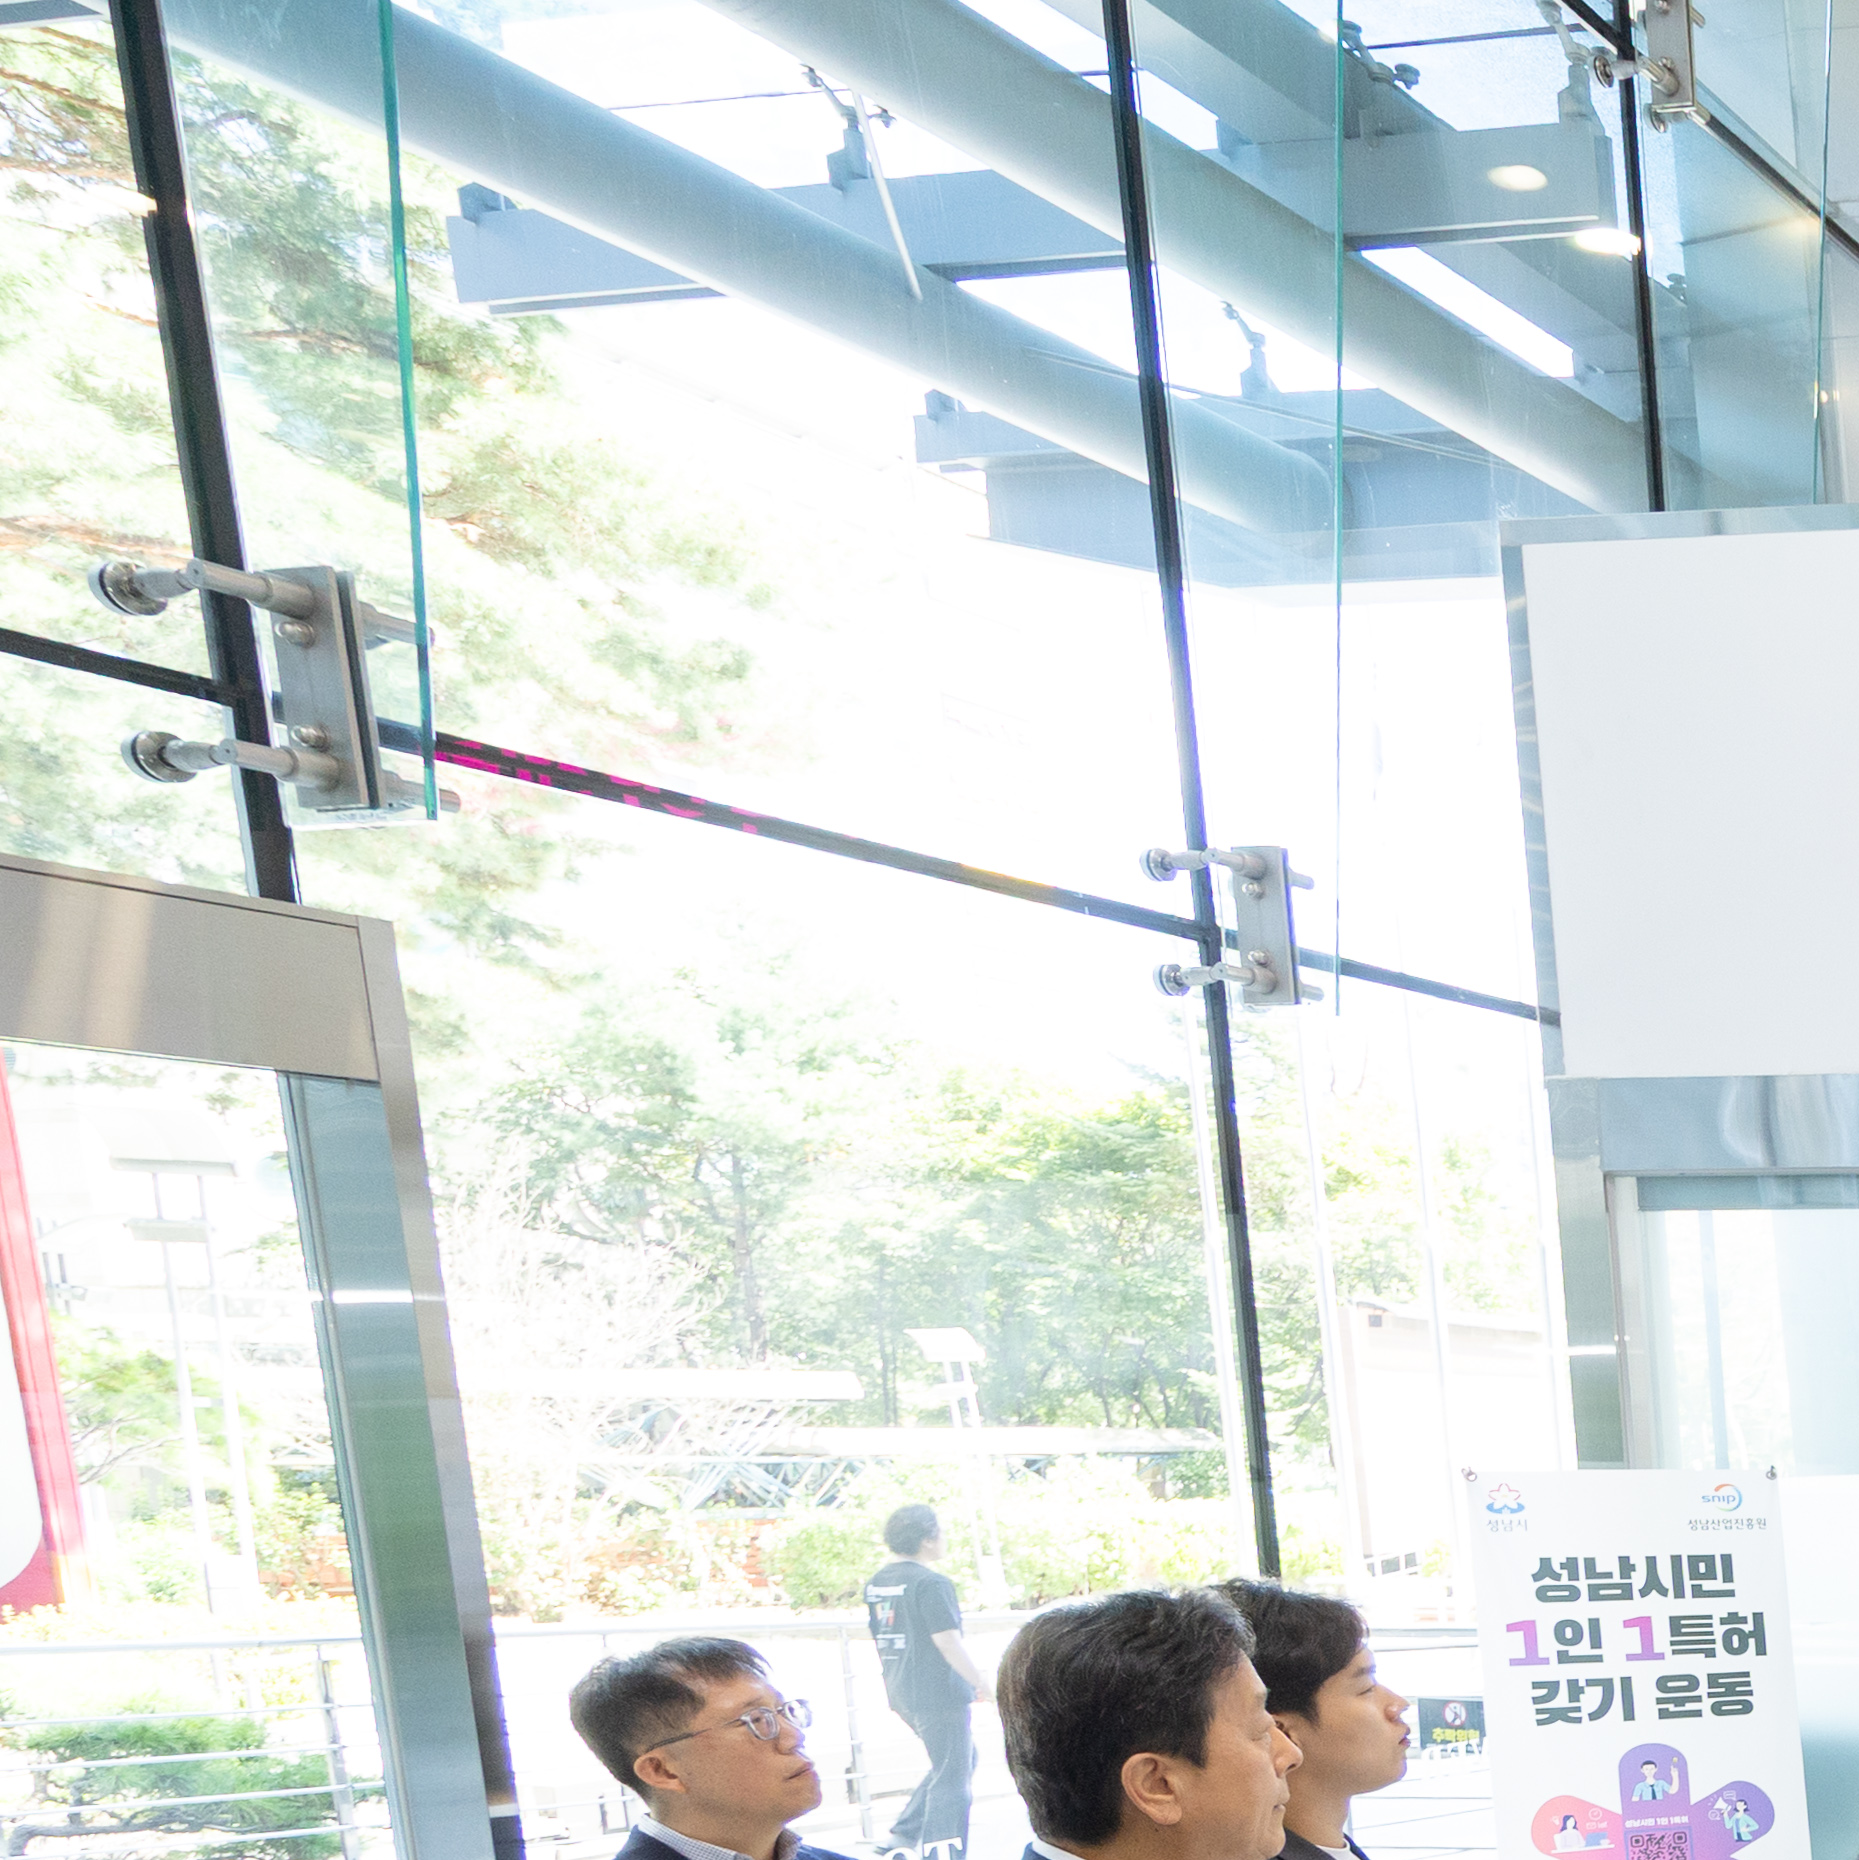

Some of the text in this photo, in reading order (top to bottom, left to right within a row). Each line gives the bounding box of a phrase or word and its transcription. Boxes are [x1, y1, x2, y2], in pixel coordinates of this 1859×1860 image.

[1702, 1495, 1736, 1504] snip
[1486, 1518, 1528, 1532] 성남시
[1688, 1518, 1766, 1530] 성남산업진흥원
[1531, 1553, 1736, 1603] 성남시민
[1506, 1612, 1766, 1666] 1인 1특허
[1531, 1671, 1754, 1726] 갖기 운동
